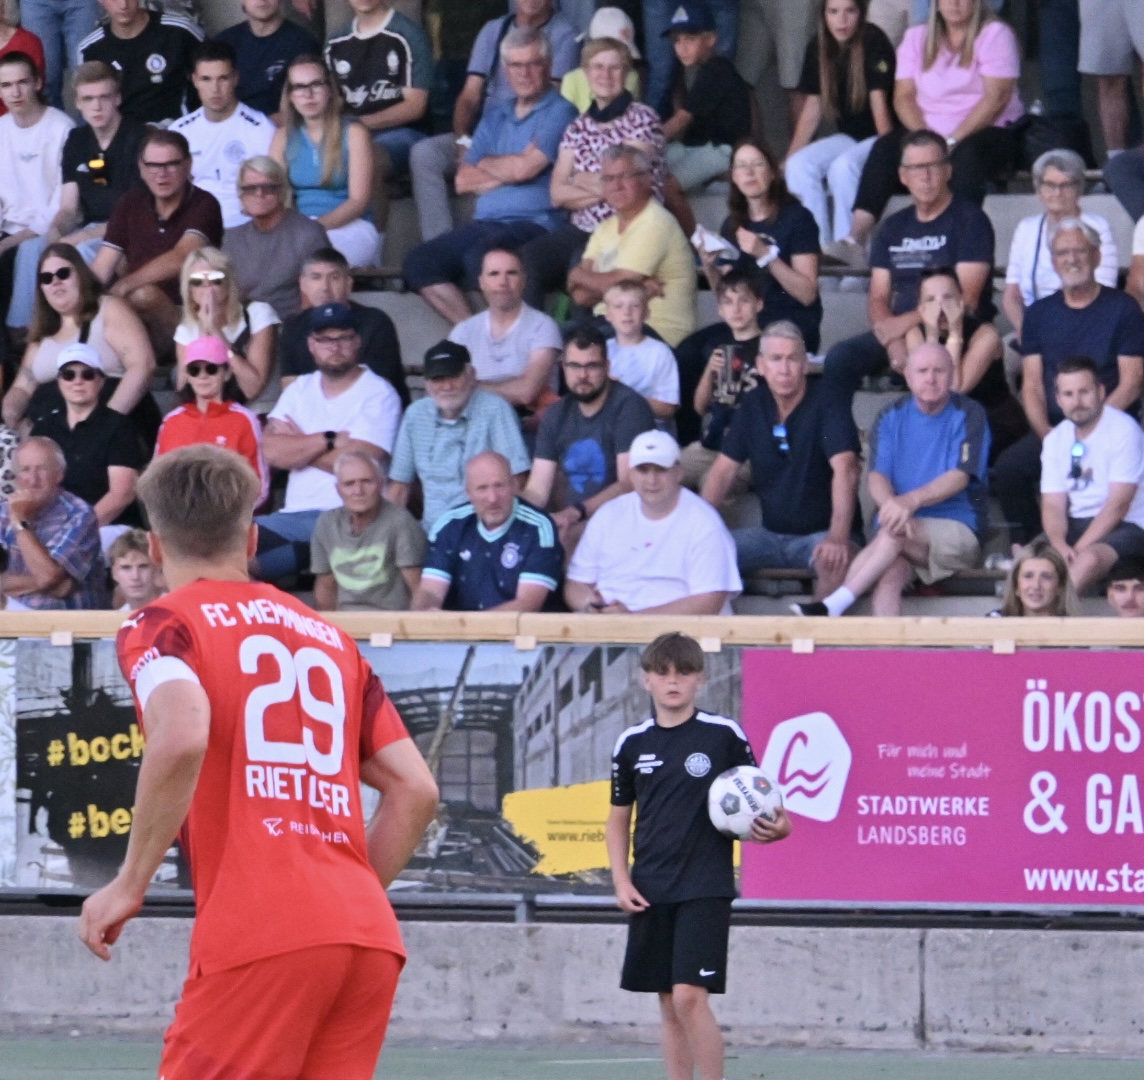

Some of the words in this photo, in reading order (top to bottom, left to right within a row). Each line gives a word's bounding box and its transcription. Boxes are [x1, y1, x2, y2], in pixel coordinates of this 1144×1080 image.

[200, 603, 237, 628] FC
[239, 634, 346, 776] 29
[943, 742, 967, 758] und
[949, 762, 992, 779] Stadt
[857, 795, 990, 816] STADTWERKE
[1022, 770, 1068, 834] &
[67, 803, 135, 839] #be
[857, 825, 967, 845] LANDSBERG
